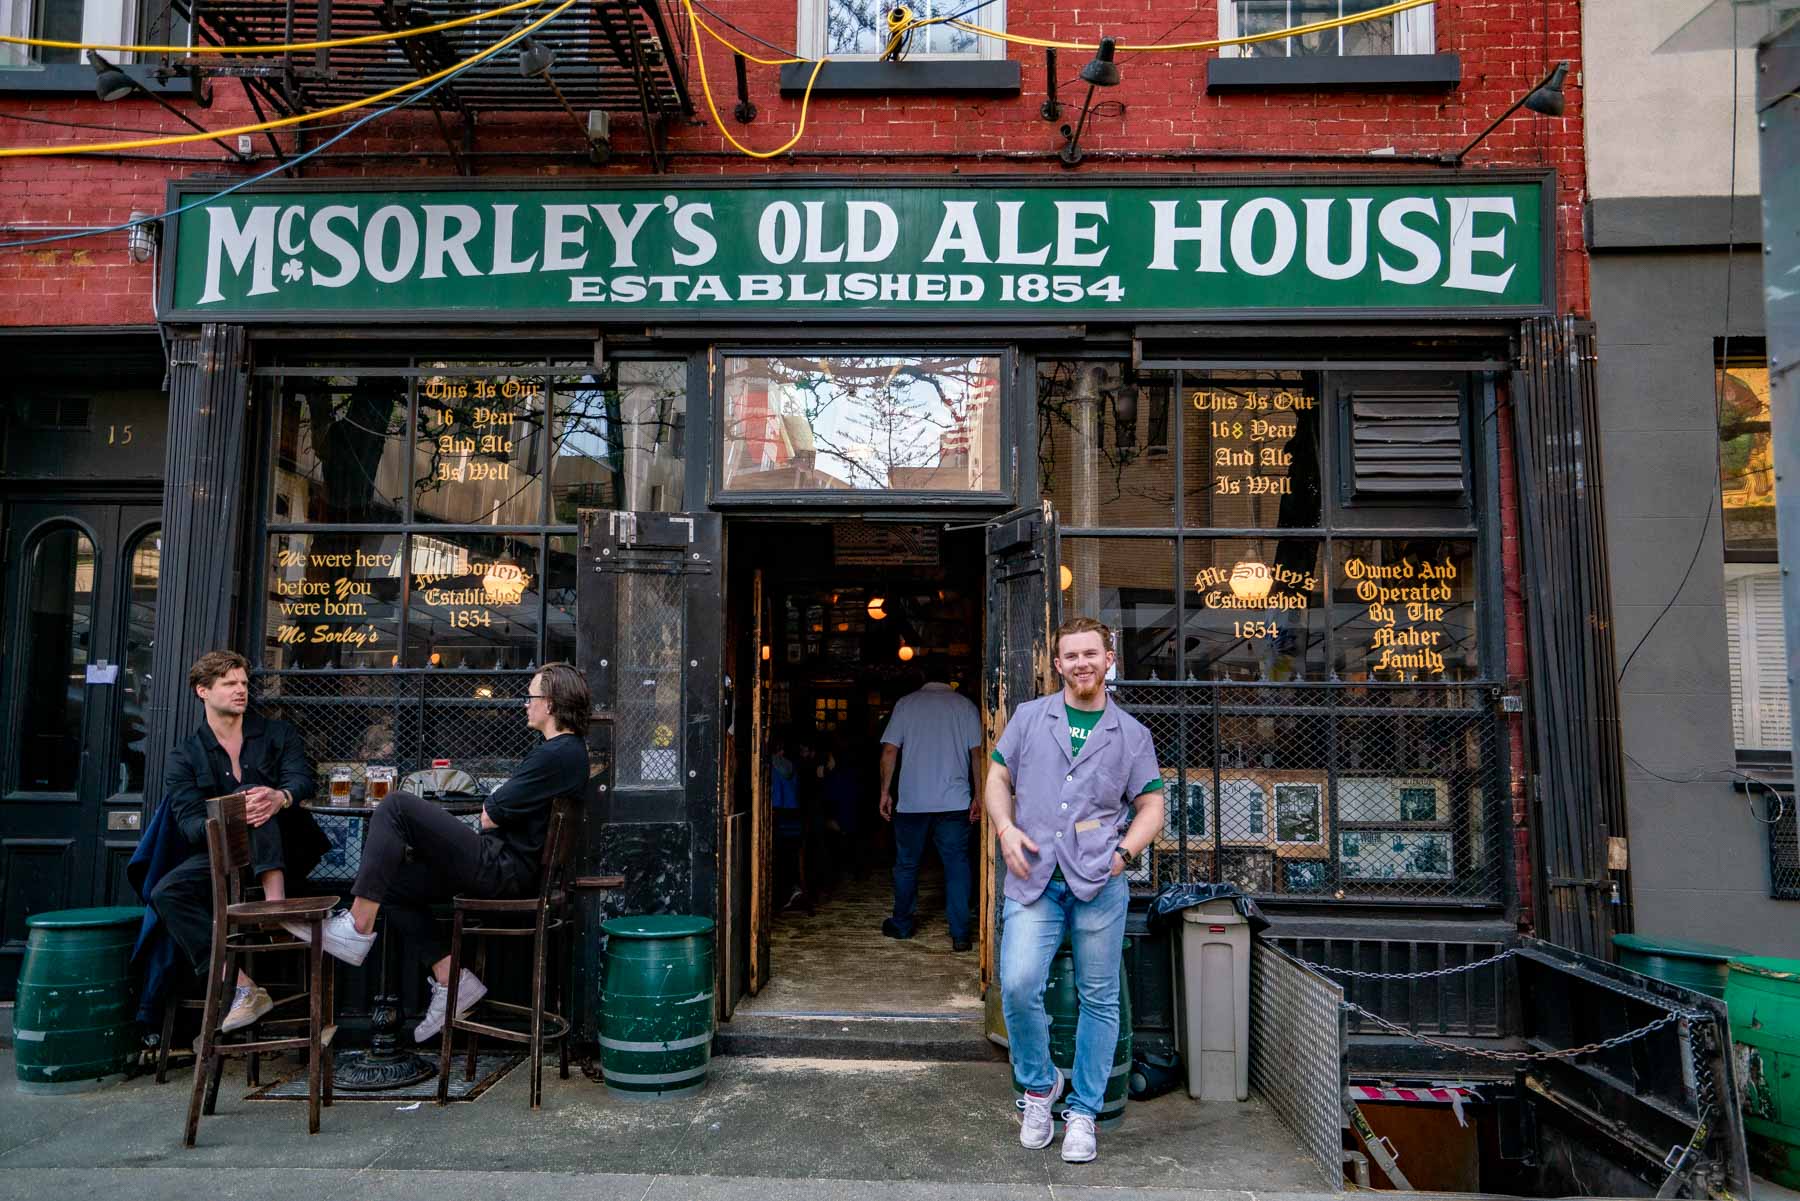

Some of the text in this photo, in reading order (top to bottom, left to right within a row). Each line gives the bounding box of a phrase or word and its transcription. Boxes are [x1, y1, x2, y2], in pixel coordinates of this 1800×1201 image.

[757, 200, 899, 265] OLD
[922, 200, 1111, 268] ALE
[1146, 196, 1518, 294] HOUSE
[568, 272, 1126, 302] ESTABLISHED 1854
[425, 381, 540, 400] This Is Our
[1192, 391, 1315, 412] This Is Our
[472, 407, 517, 429] Year
[108, 423, 132, 446] 15
[1210, 419, 1296, 441] 168 Year
[438, 434, 513, 453] And Ale
[1215, 447, 1293, 466] And Ale
[437, 462, 510, 481] Is Well
[1215, 475, 1293, 495] Is Well
[278, 549, 392, 567] We were here
[1344, 556, 1457, 579] Owned And
[277, 577, 372, 601] before You
[1194, 562, 1319, 594] Mc Sorley's
[424, 588, 521, 608] Established
[1204, 590, 1308, 612] Established
[1356, 580, 1452, 605] Operated
[280, 598, 367, 616] were born.
[1368, 602, 1445, 628] By The
[449, 610, 492, 628] 1854
[1233, 620, 1279, 639] 1854
[277, 624, 379, 648] Mc Sorley's
[1370, 626, 1441, 649] Maher
[1373, 647, 1446, 674] Family
